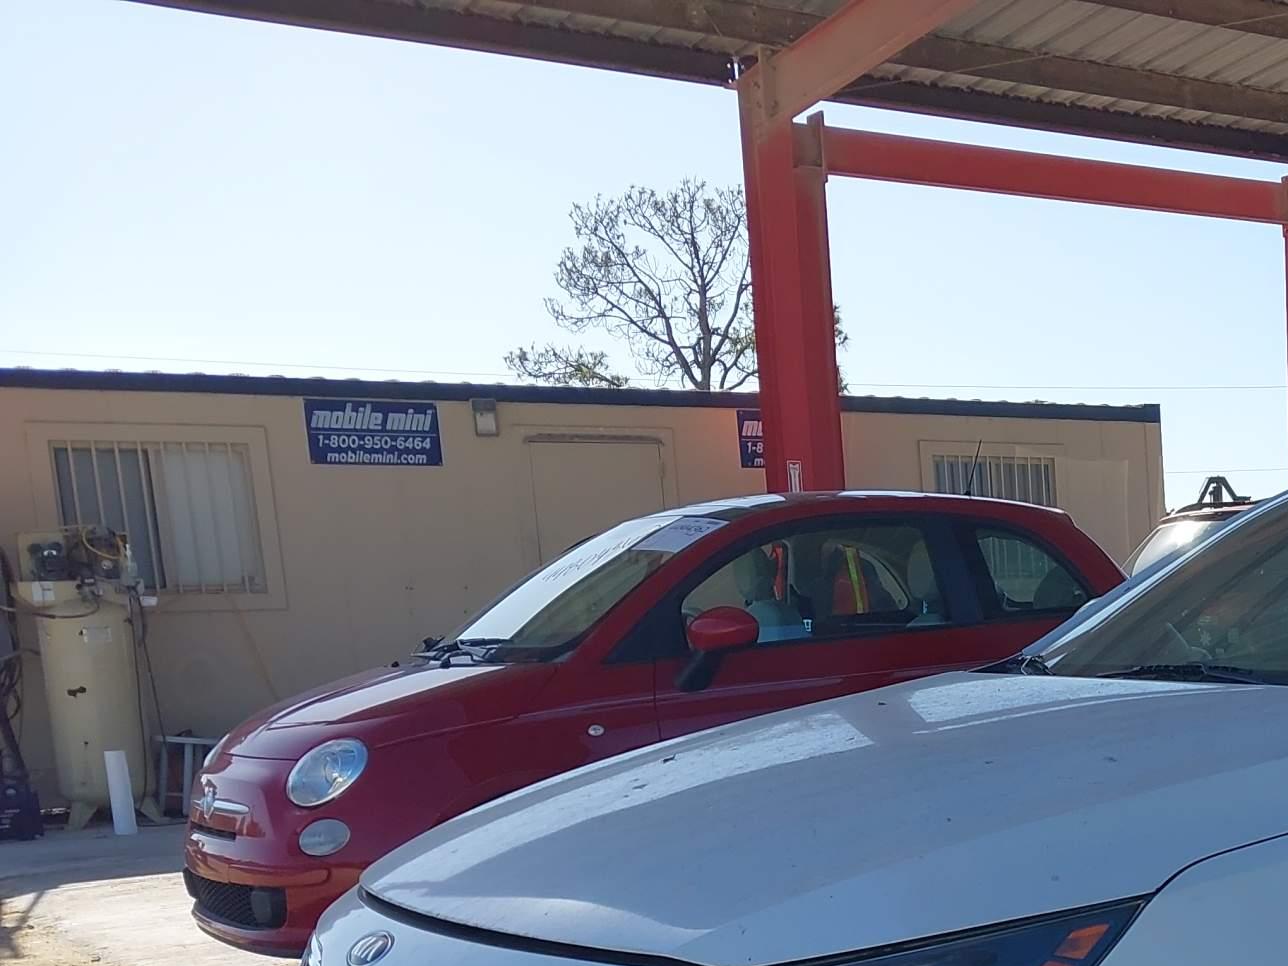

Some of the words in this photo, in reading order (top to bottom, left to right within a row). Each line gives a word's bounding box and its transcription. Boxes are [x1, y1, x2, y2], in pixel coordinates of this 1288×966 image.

[311, 402, 383, 430] mobile
[386, 409, 432, 431] mini
[318, 435, 431, 449] 1-800-950-6464
[327, 451, 427, 464] mobilemini.com
